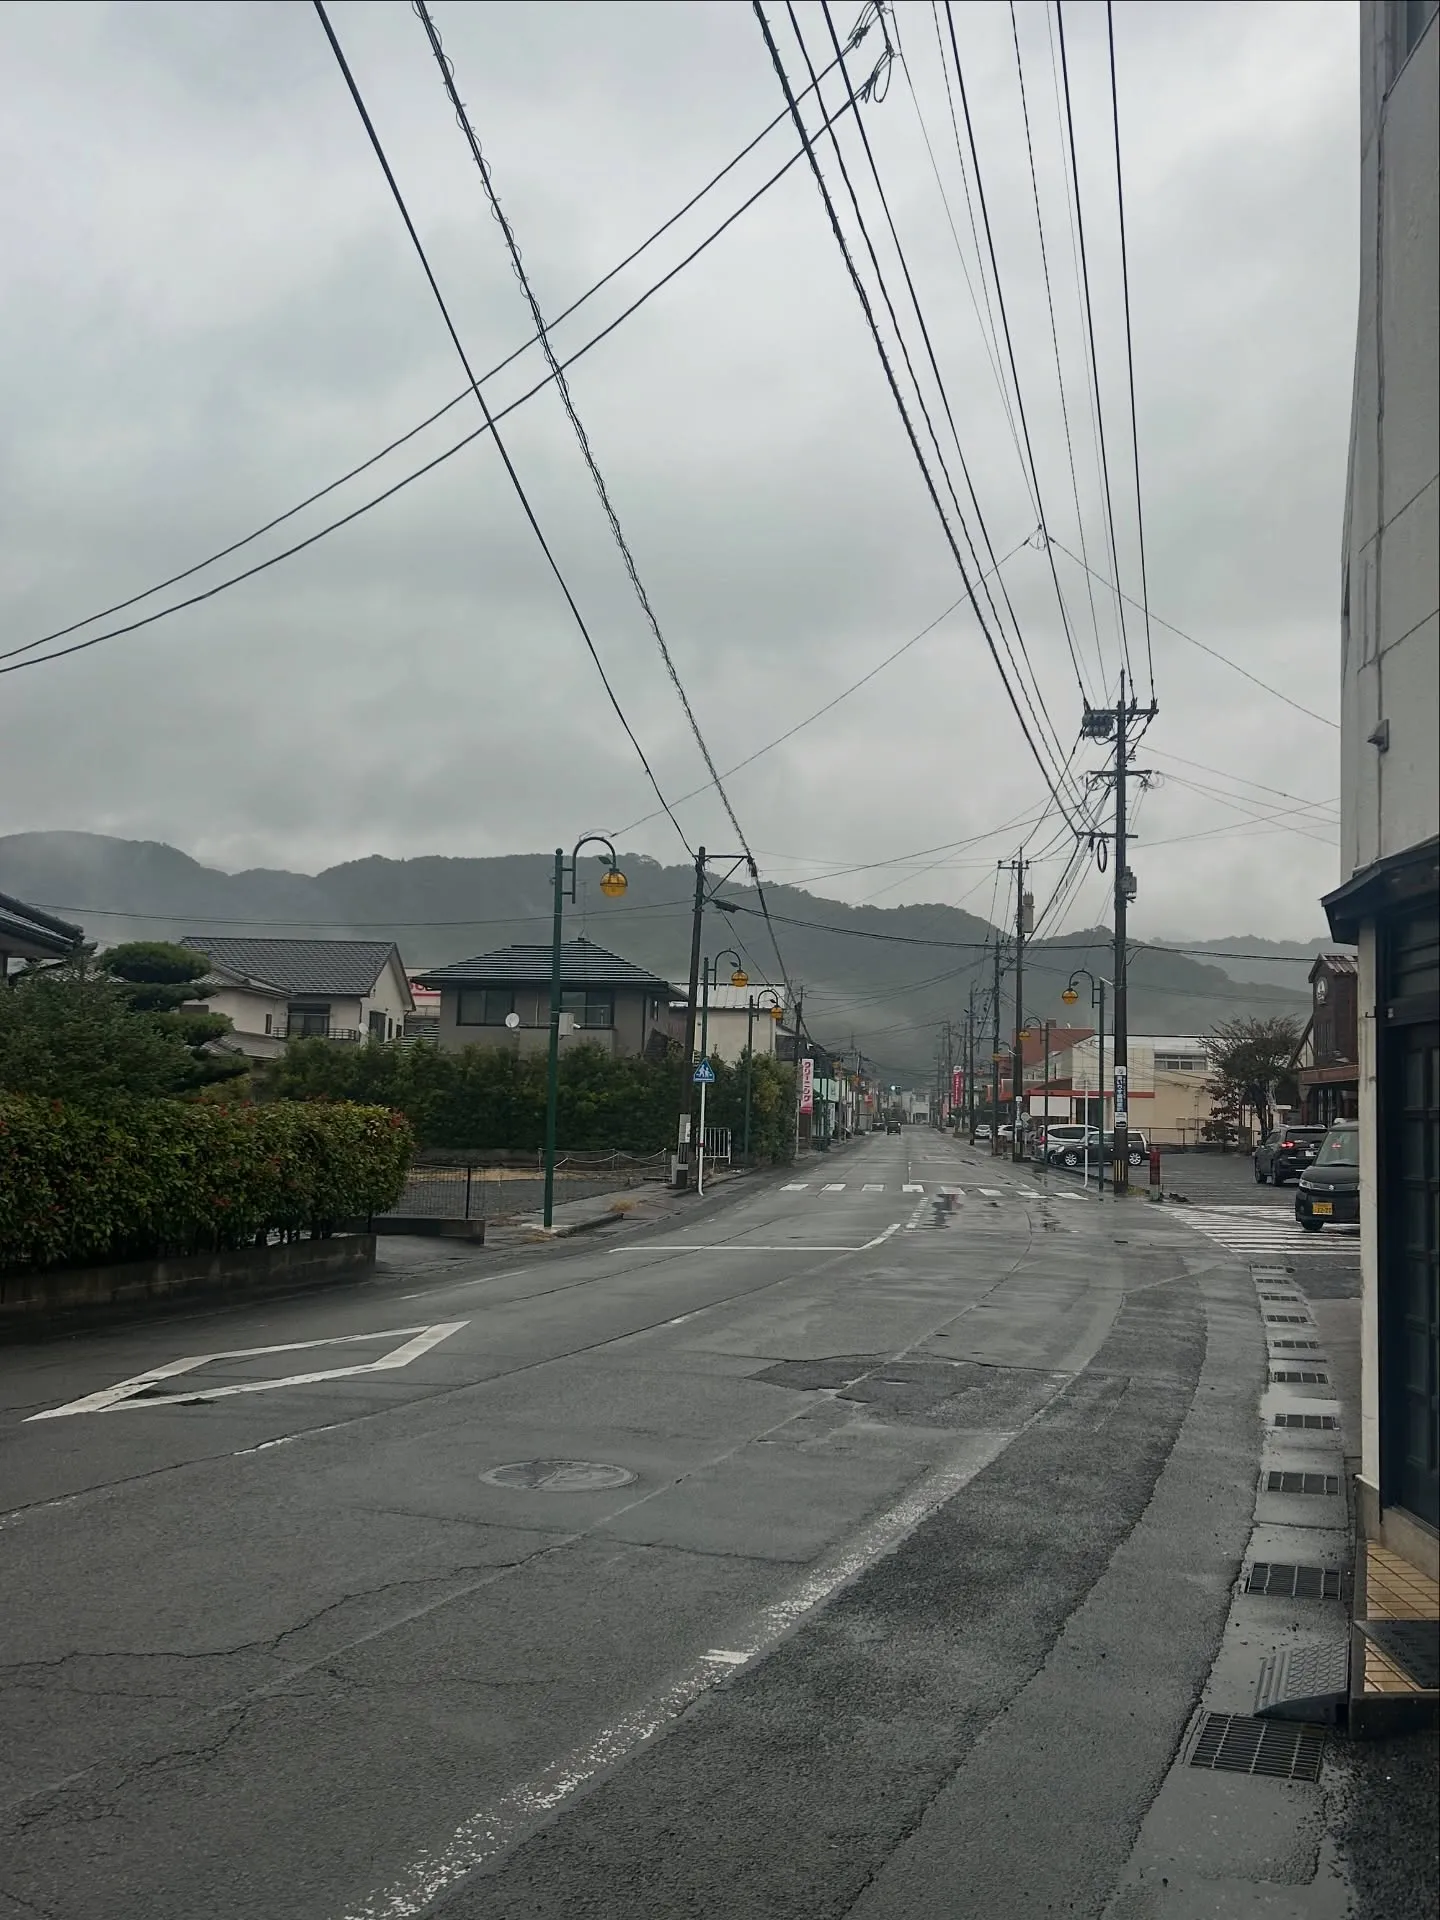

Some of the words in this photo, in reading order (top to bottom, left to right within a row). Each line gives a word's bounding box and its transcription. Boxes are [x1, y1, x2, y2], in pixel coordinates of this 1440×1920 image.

[803, 1061, 811, 1102] クリーニング
